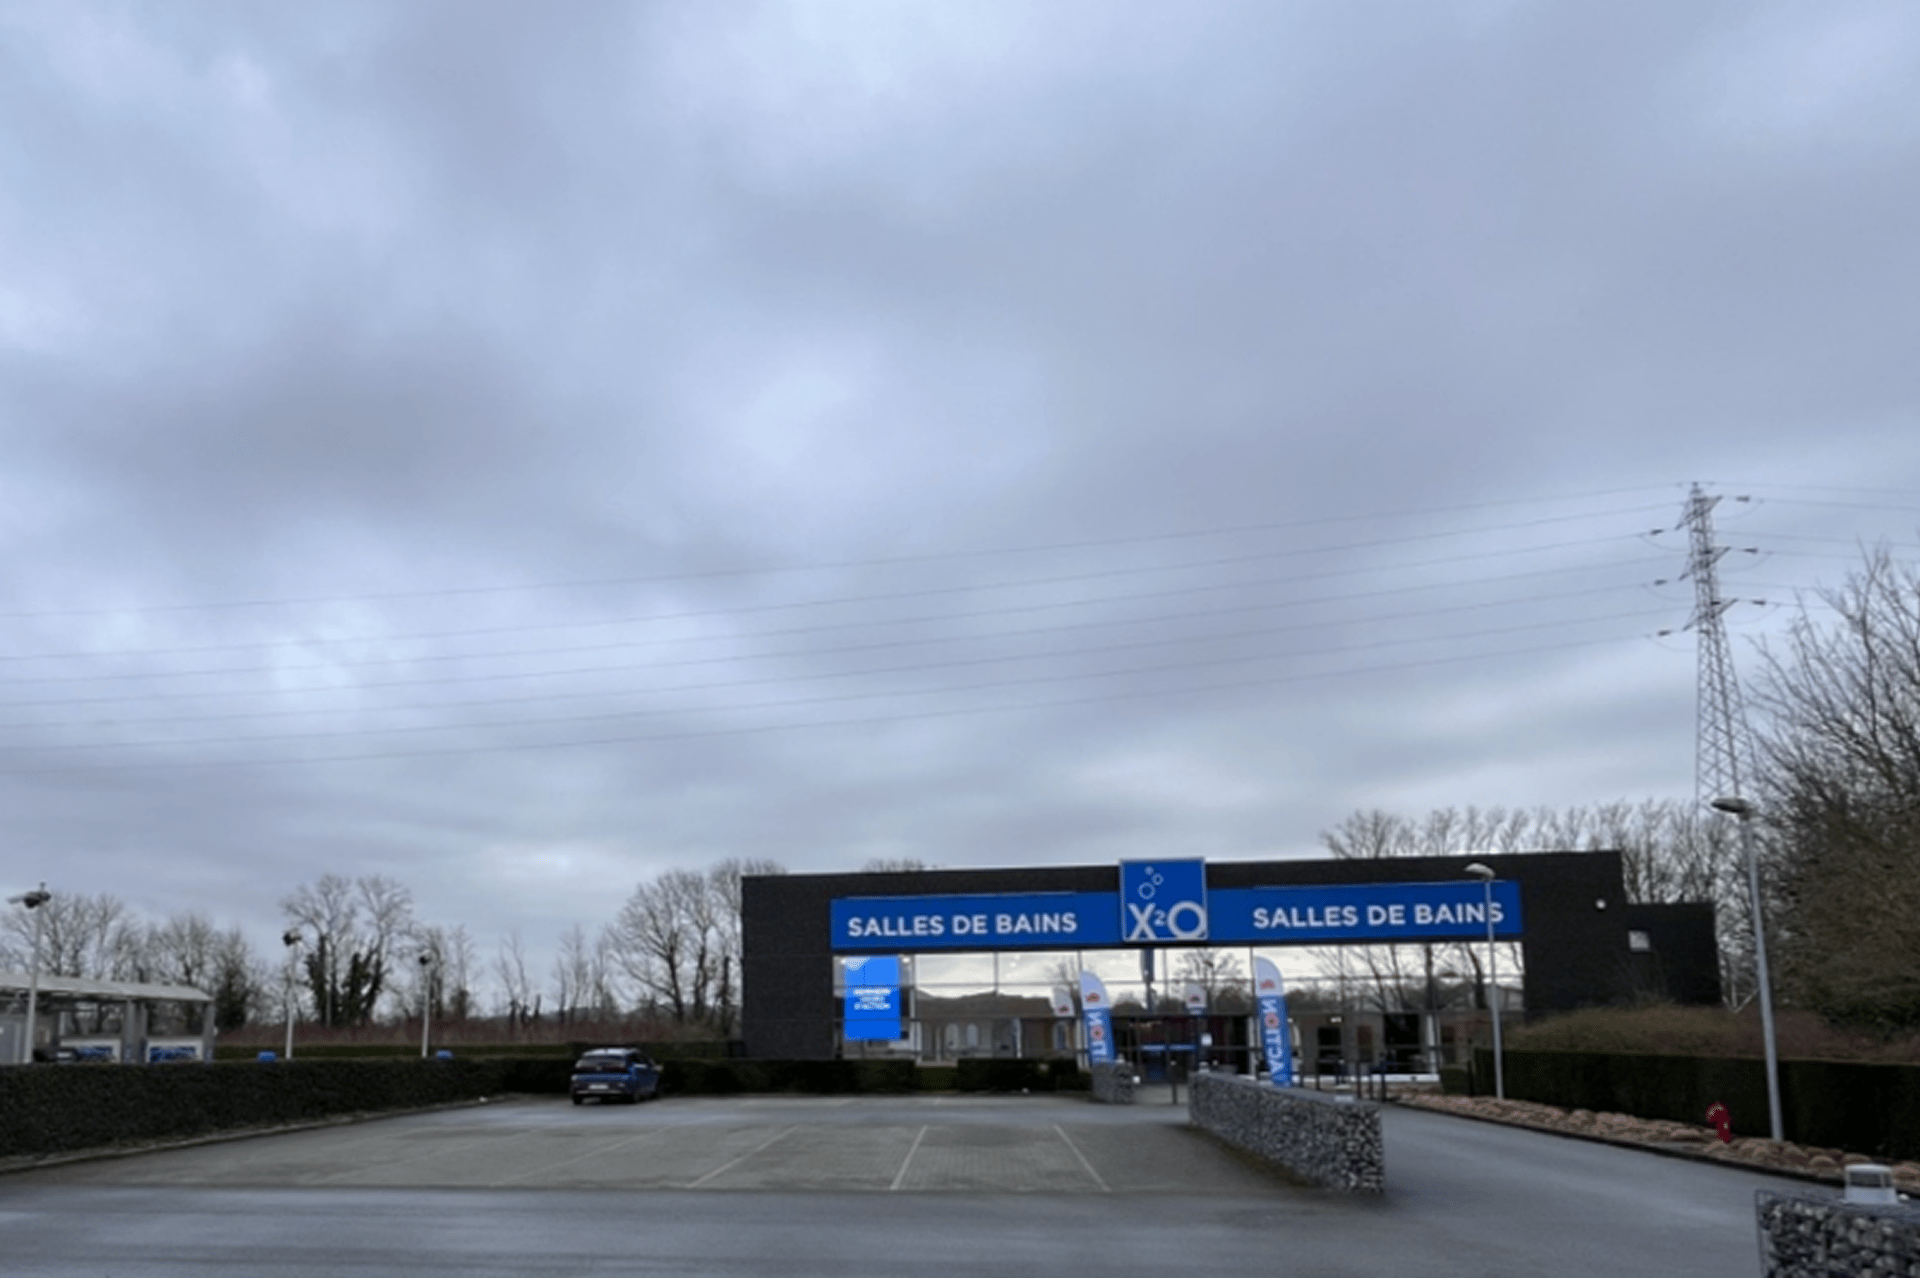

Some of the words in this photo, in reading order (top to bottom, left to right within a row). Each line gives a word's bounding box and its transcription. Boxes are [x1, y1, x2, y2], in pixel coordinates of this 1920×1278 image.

[847, 915, 944, 937] SALLES
[952, 914, 988, 935] DE
[995, 912, 1078, 934] BAINS
[1253, 906, 1358, 928] SALLES
[1367, 904, 1405, 926] DE
[1414, 903, 1504, 925] BAINS
